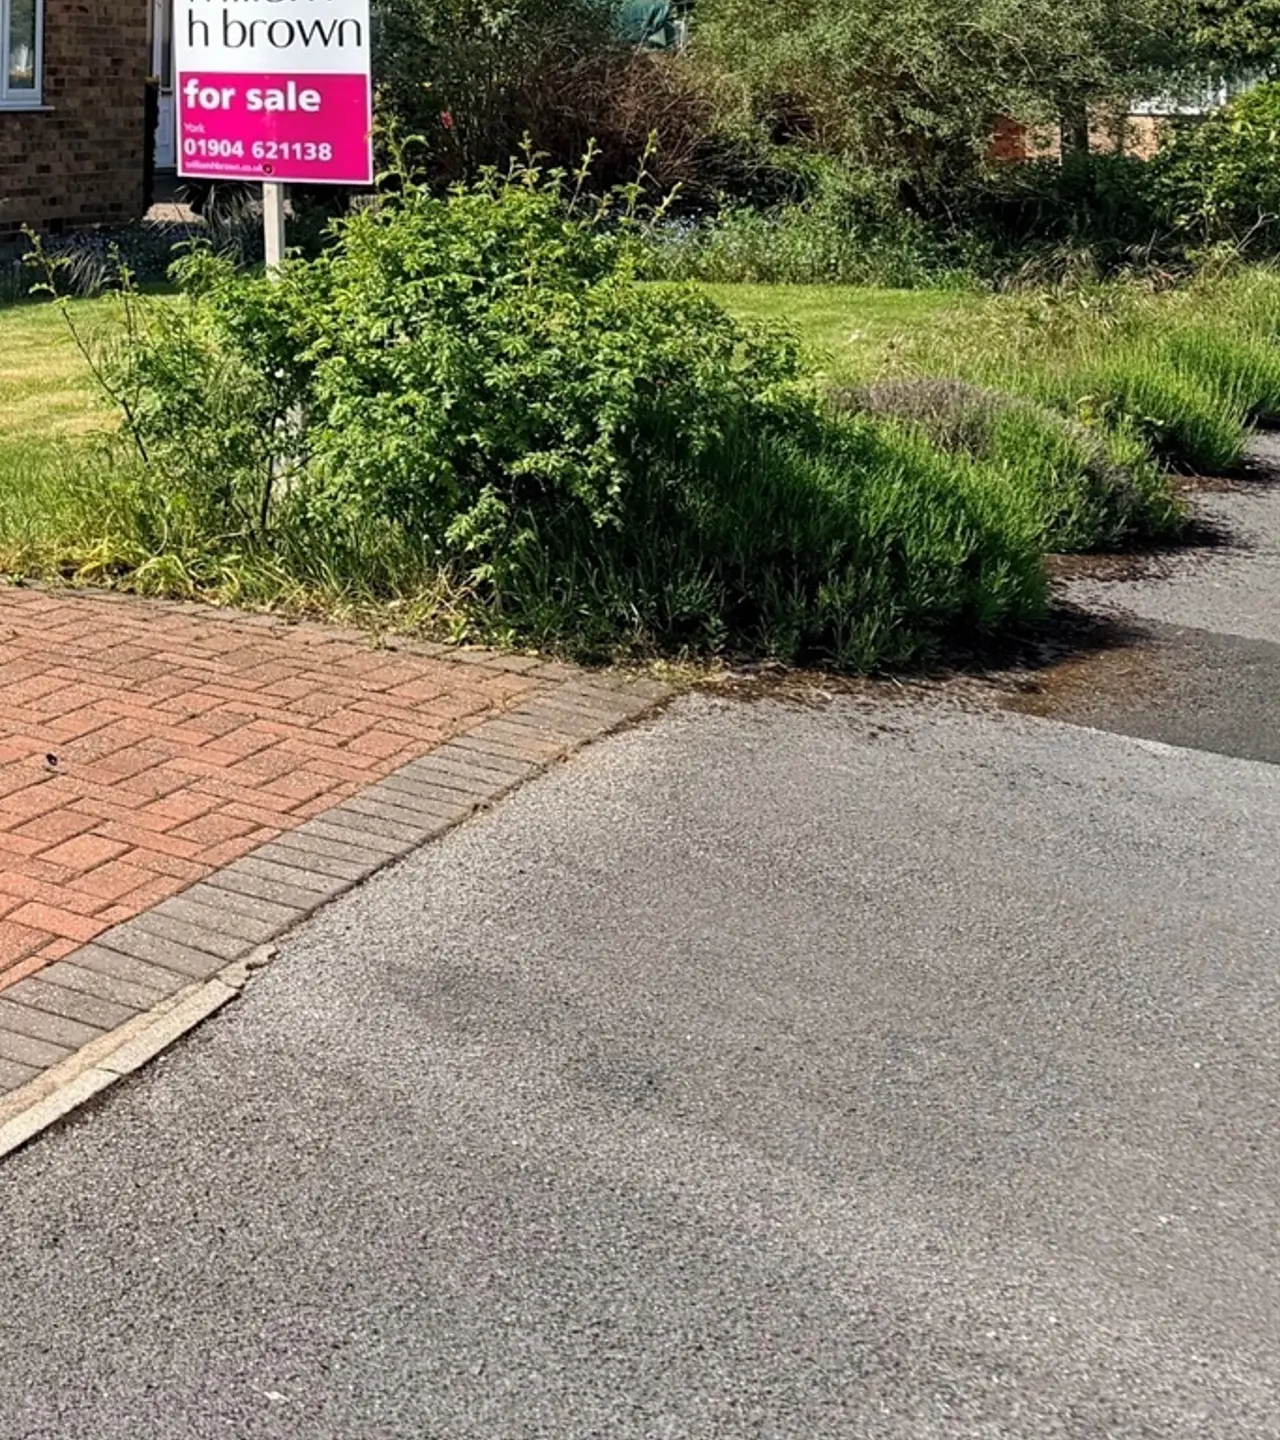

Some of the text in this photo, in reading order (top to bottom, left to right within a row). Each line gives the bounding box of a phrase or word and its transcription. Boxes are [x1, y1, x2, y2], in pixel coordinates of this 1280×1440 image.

[188, 8, 362, 49] h brown
[183, 78, 322, 112] for sale
[183, 122, 206, 133] York
[183, 138, 333, 162] 01904 621138
